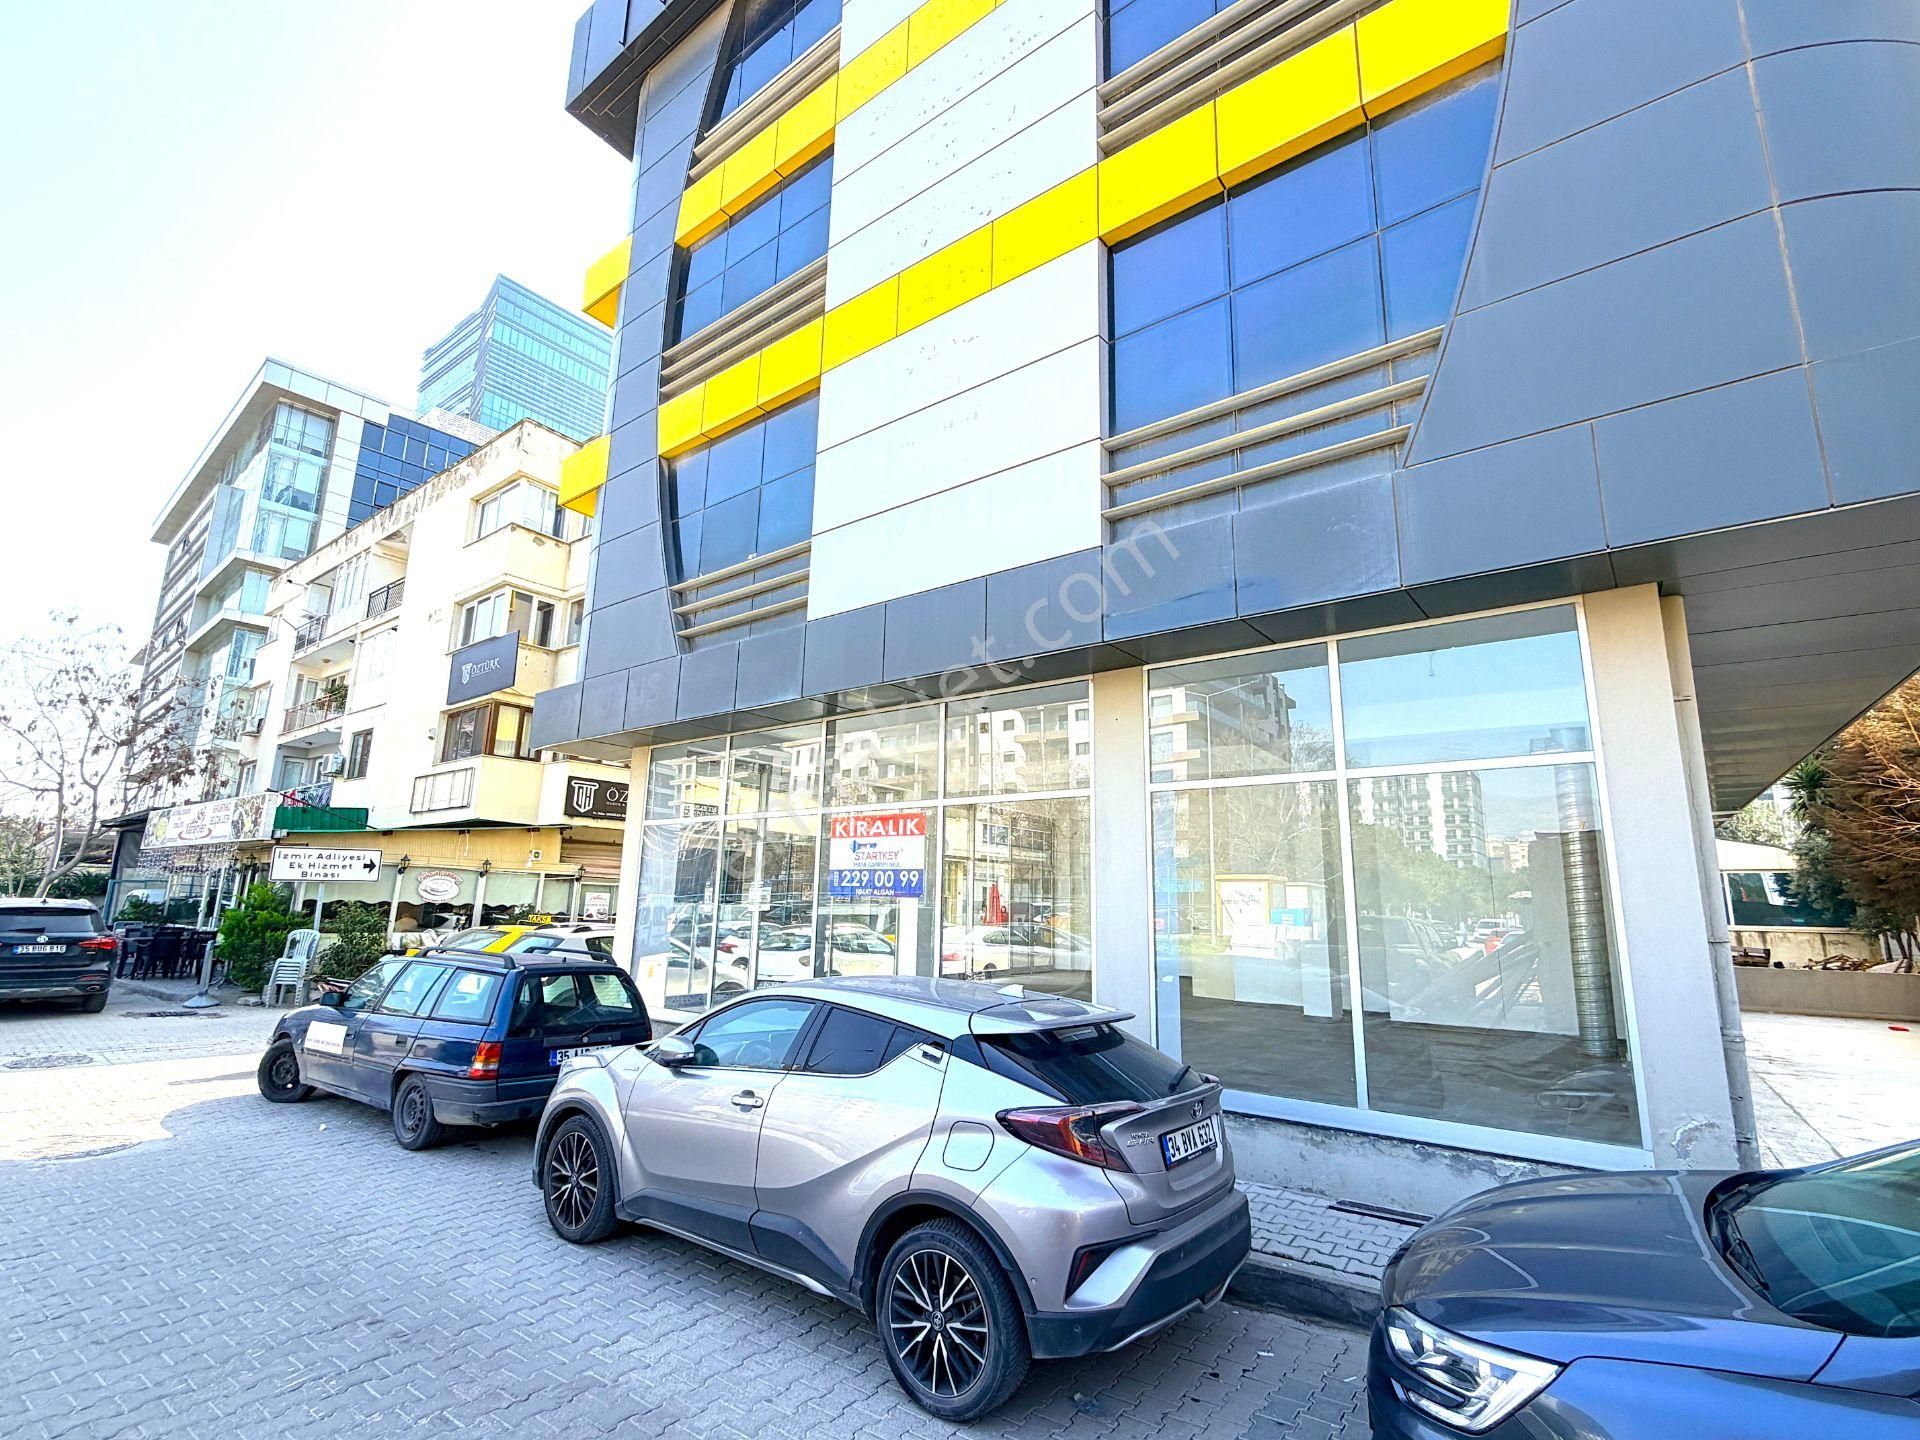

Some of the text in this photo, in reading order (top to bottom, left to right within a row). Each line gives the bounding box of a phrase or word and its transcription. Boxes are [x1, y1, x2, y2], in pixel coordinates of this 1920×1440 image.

[835, 816, 921, 838] KİRALIK
[316, 852, 366, 862] Adliyesi
[854, 851, 900, 861] STARTKEY
[289, 861, 354, 870] Ek Hizmet
[301, 871, 340, 879] Binası
[840, 870, 870, 887] 229
[874, 870, 895, 888] 00
[899, 870, 919, 888] 99
[873, 888, 895, 896] ALGAN
[557, 1050, 570, 1063] 35
[1168, 1134, 1182, 1159] 34
[1197, 1122, 1213, 1146] 632
